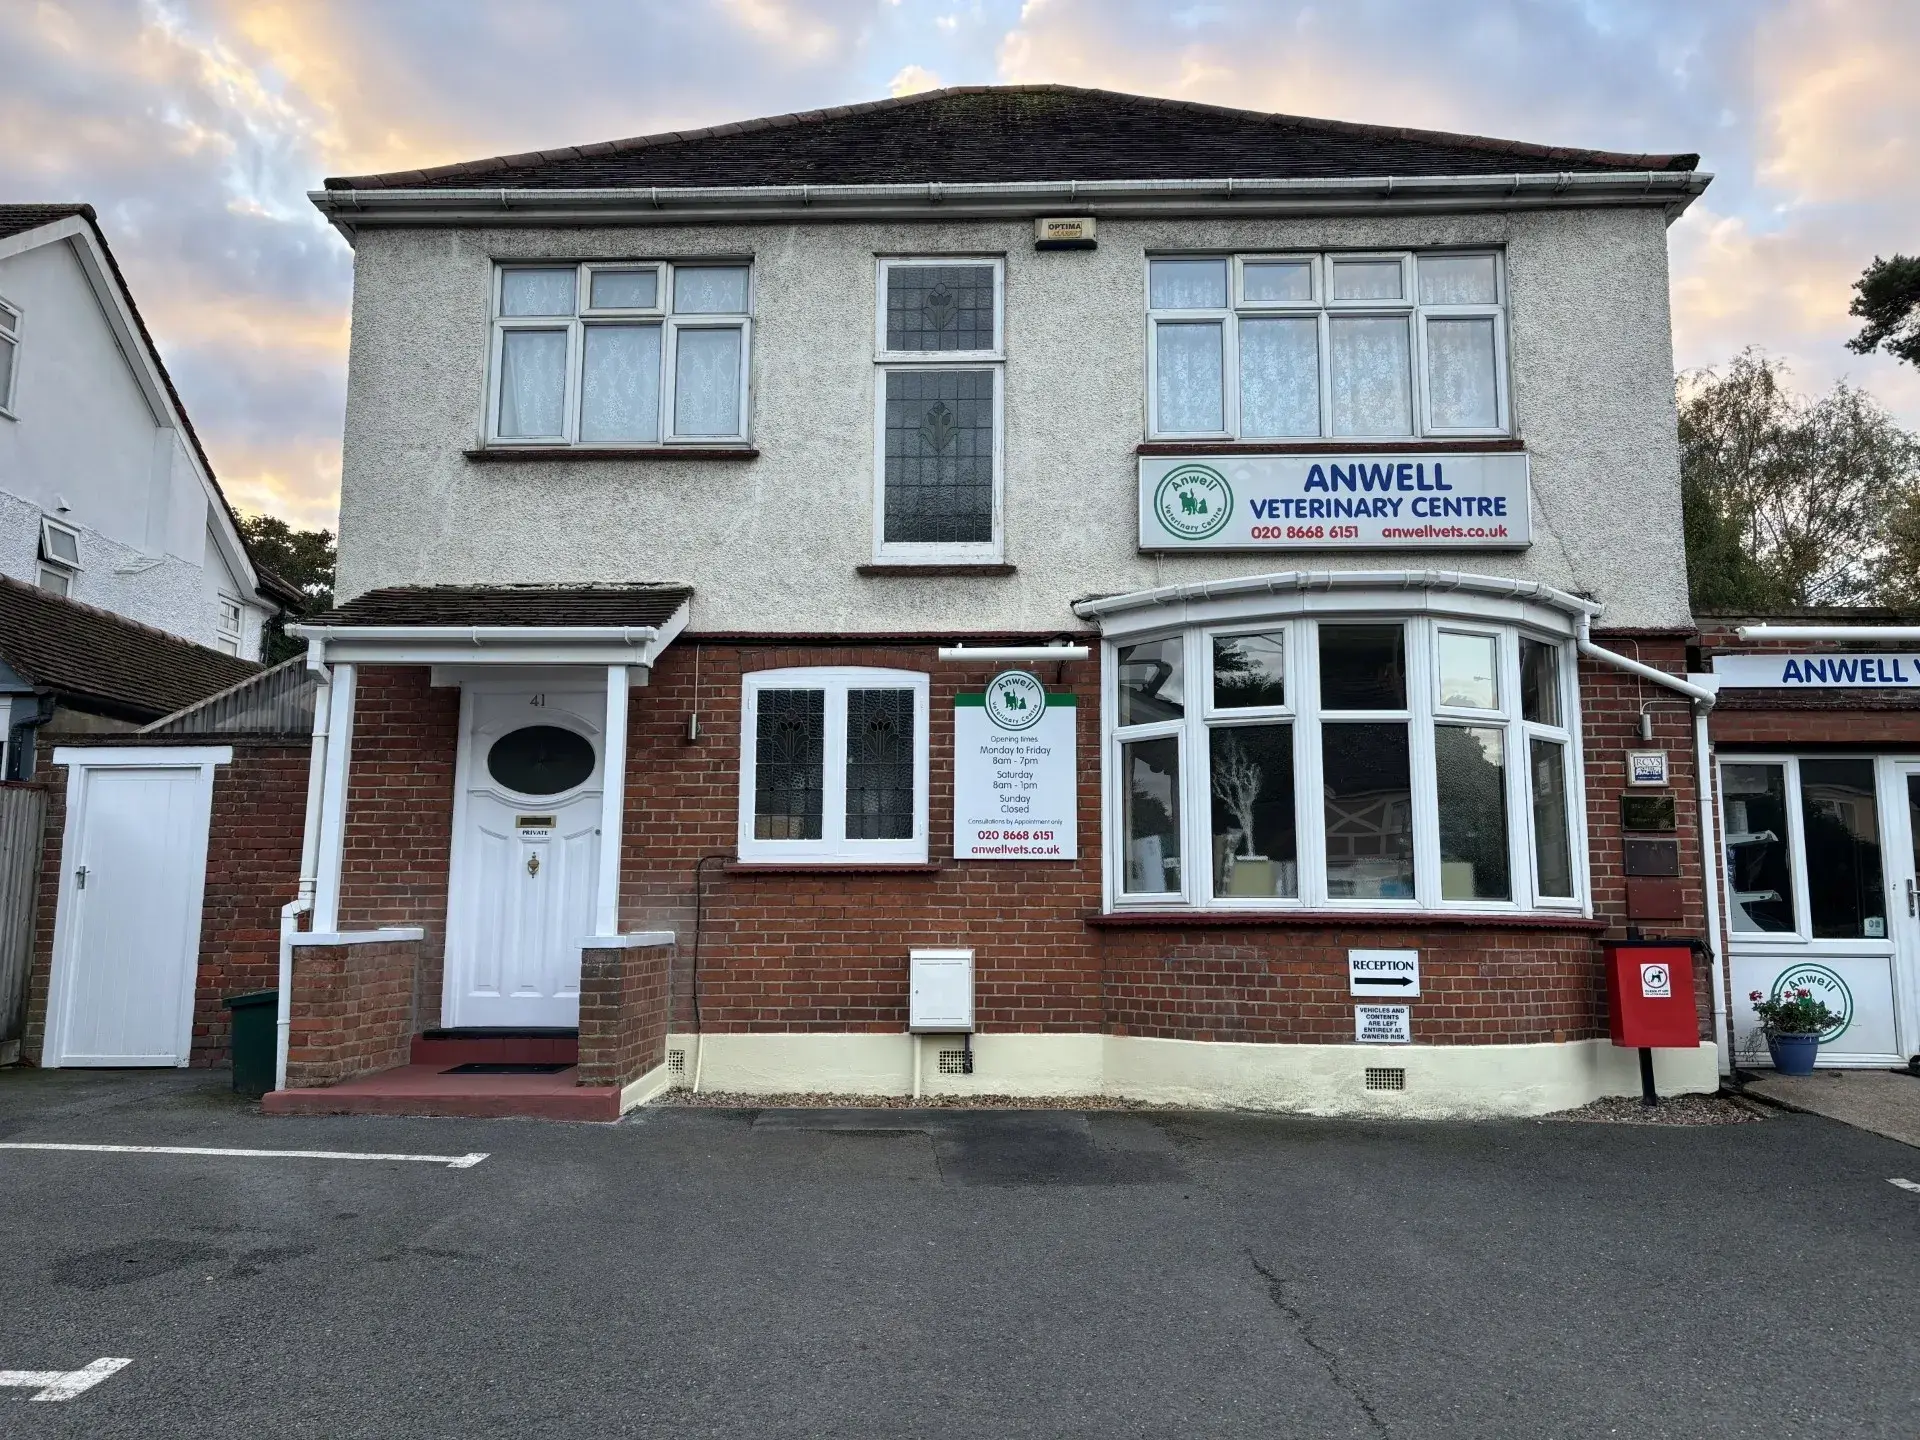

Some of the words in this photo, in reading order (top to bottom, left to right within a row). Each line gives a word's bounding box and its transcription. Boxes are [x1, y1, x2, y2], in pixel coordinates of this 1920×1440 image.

[1171, 475, 1218, 491] Anwell
[1304, 462, 1453, 493] ANWELL
[1250, 497, 1403, 519] VETERINARY
[1411, 496, 1507, 517] CENTRE
[1165, 504, 1199, 531] Veterinary
[1201, 507, 1222, 529] Centre
[1251, 525, 1281, 539] 020
[1286, 525, 1324, 539] 8668
[1329, 525, 1359, 539] 6151
[1382, 524, 1508, 539] anwellvets.co.uk
[1782, 658, 1909, 683] ANWELL
[997, 678, 1034, 691] Anwell
[529, 693, 545, 707] 41
[990, 736, 1019, 744] Opening
[980, 745, 1015, 756] Monday
[1016, 746, 1024, 754] to
[1026, 746, 1051, 756] Friday
[1019, 756, 1039, 766] 7pm
[1636, 758, 1661, 766] RCVS
[996, 770, 1034, 780] Saturday
[992, 781, 1012, 789] 8am
[1020, 781, 1038, 791] 1pm
[999, 794, 1031, 804] Sunday
[1000, 805, 1030, 813] Closed
[1006, 818, 1013, 826] by
[1014, 818, 1050, 826] Appointment
[977, 830, 999, 840] 020
[1003, 830, 1029, 840] 8668
[1033, 830, 1054, 840] 6151
[971, 844, 1060, 855] anwellvets.co.uk
[1353, 960, 1414, 971] RECEPTION
[1788, 975, 1836, 992] Anwell
